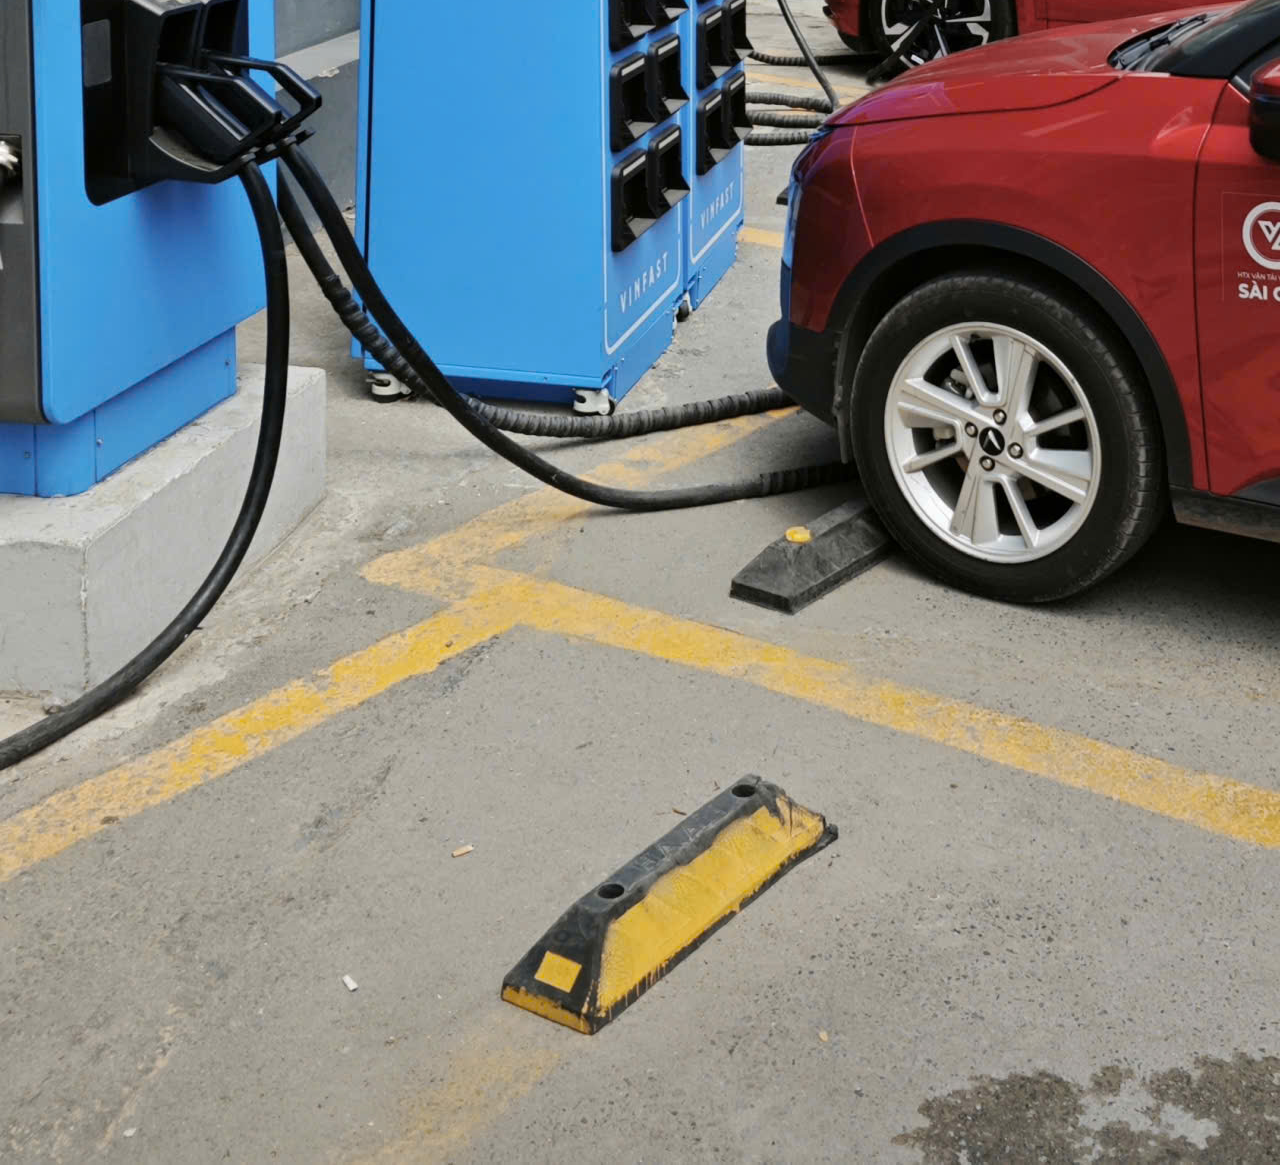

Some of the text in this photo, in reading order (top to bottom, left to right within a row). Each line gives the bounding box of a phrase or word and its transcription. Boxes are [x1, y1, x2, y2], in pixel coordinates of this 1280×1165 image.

[700, 180, 735, 230] VINFAST
[619, 251, 669, 314] VINFAST
[1238, 280, 1268, 301] SÀI
